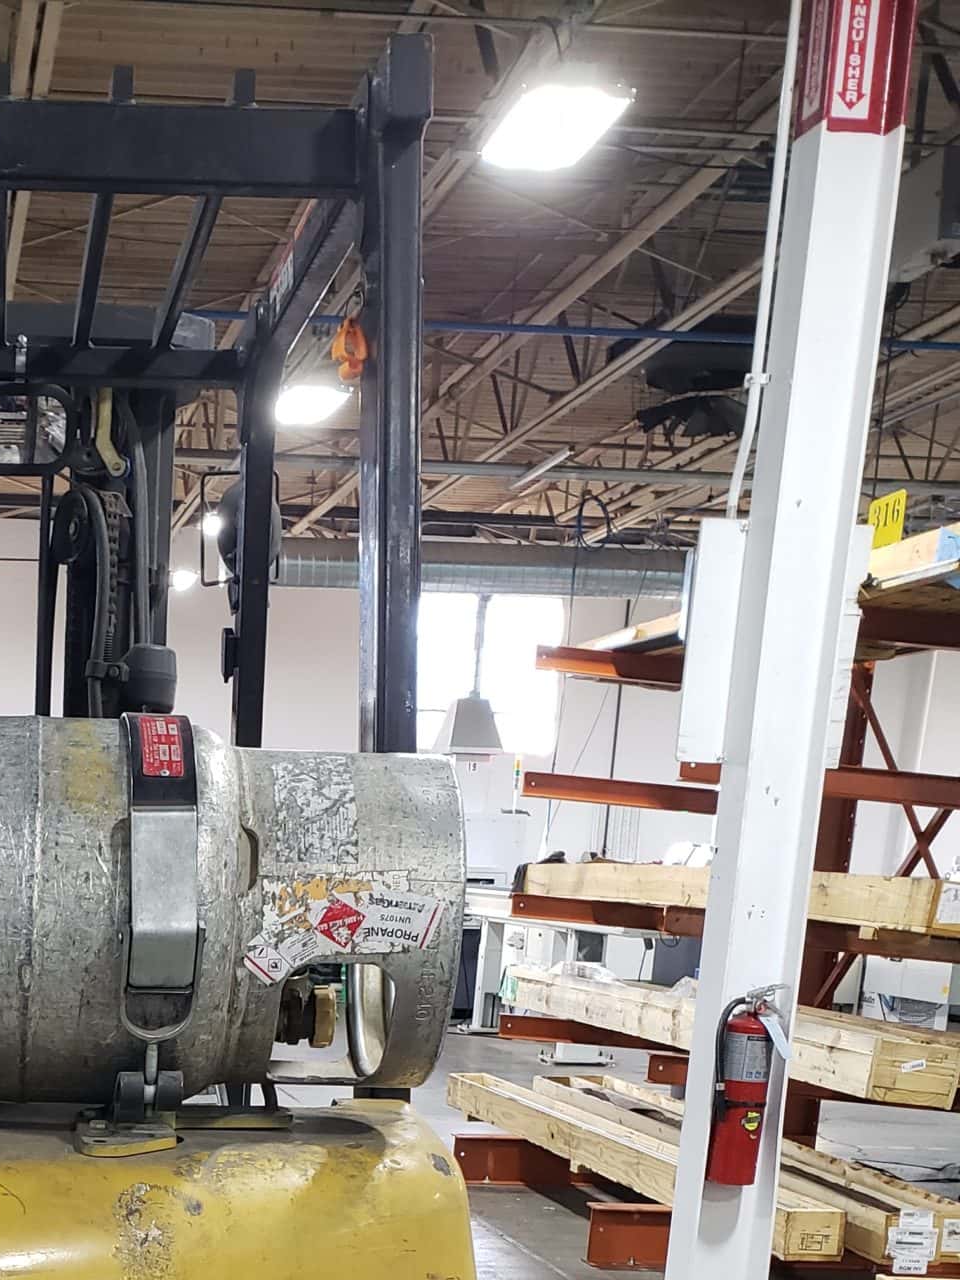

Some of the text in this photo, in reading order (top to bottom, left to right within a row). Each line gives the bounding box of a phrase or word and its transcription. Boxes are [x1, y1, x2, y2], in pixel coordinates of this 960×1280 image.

[874, 498, 900, 530] 316
[379, 914, 411, 925] UN1075
[362, 927, 420, 943] PROPANE
